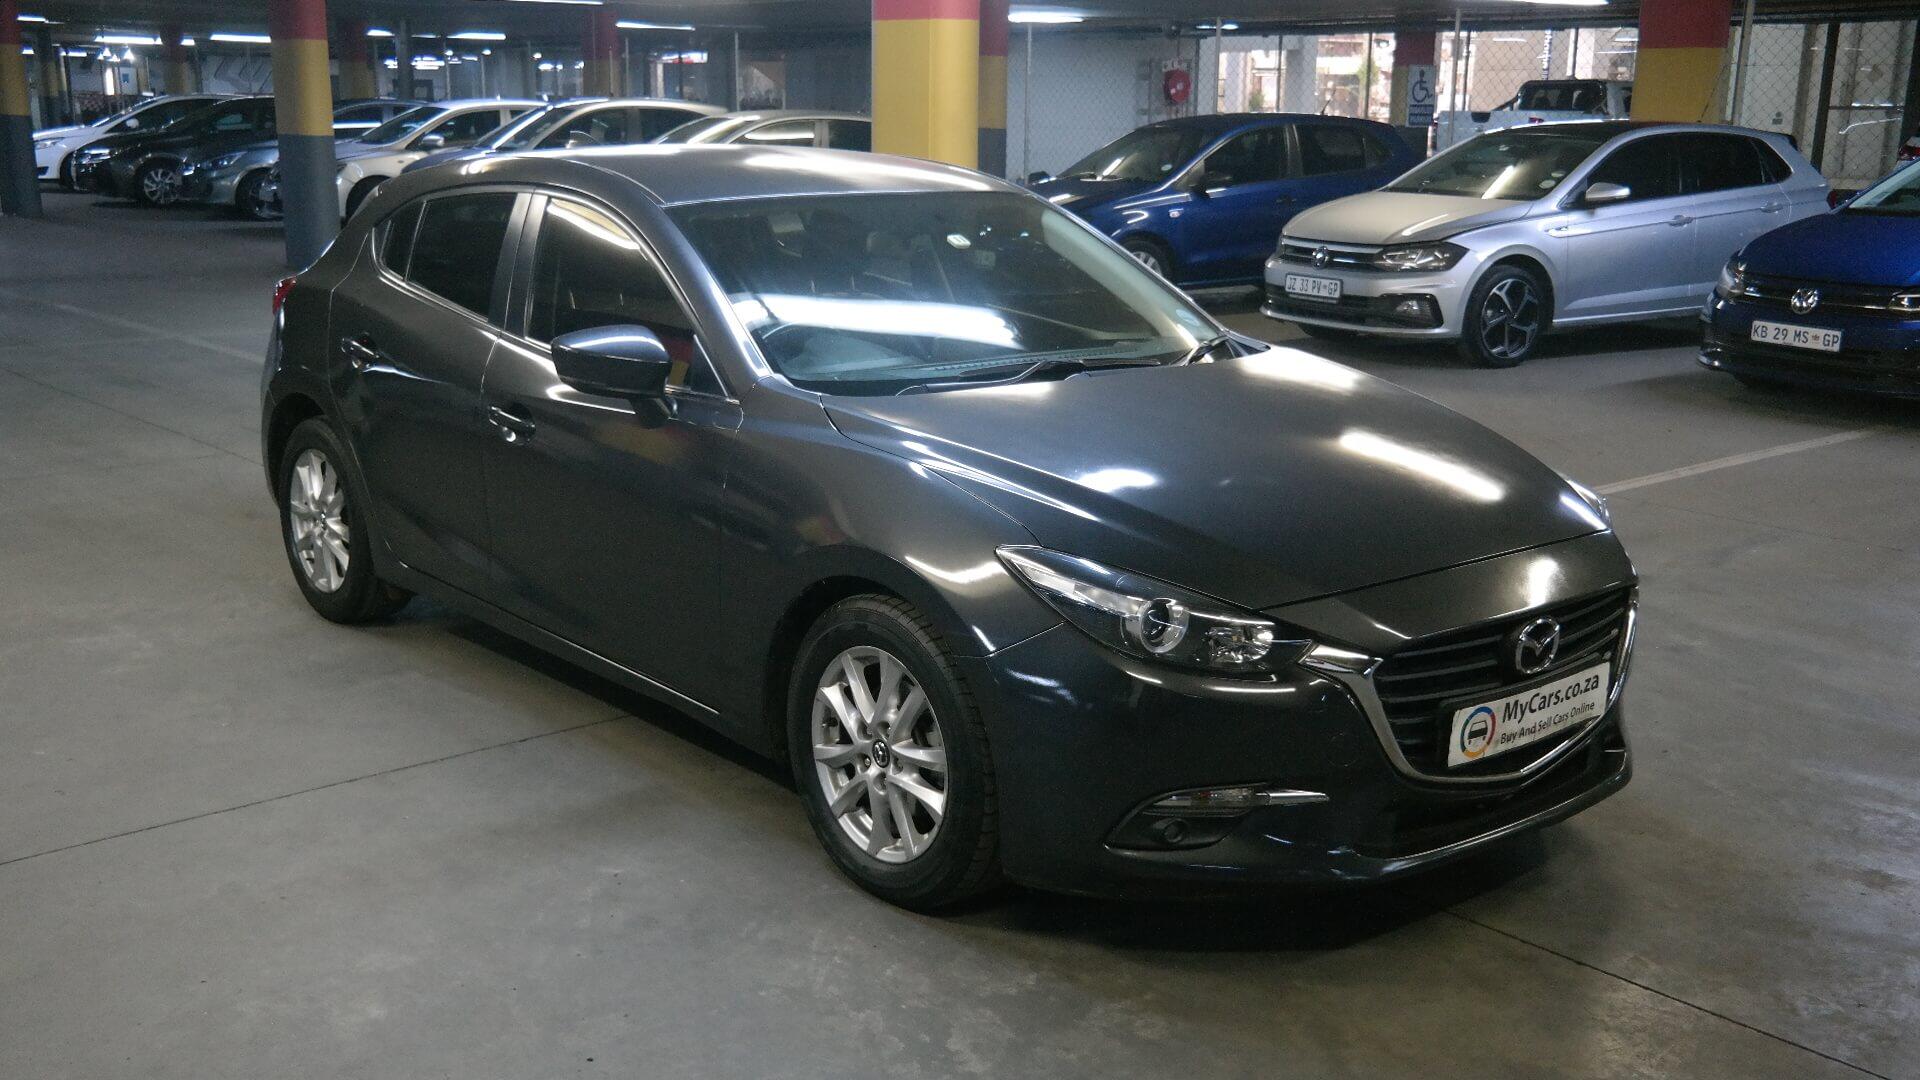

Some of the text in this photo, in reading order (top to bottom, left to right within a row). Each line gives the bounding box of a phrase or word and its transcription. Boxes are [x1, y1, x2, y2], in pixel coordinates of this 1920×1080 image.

[1299, 278, 1309, 292] 33
[1327, 282, 1338, 296] GP
[1752, 324, 1840, 347] KB 29 MS GP
[1502, 674, 1599, 724] MyCars.co.za
[1500, 702, 1595, 745] Buy And Sell Cars Online
